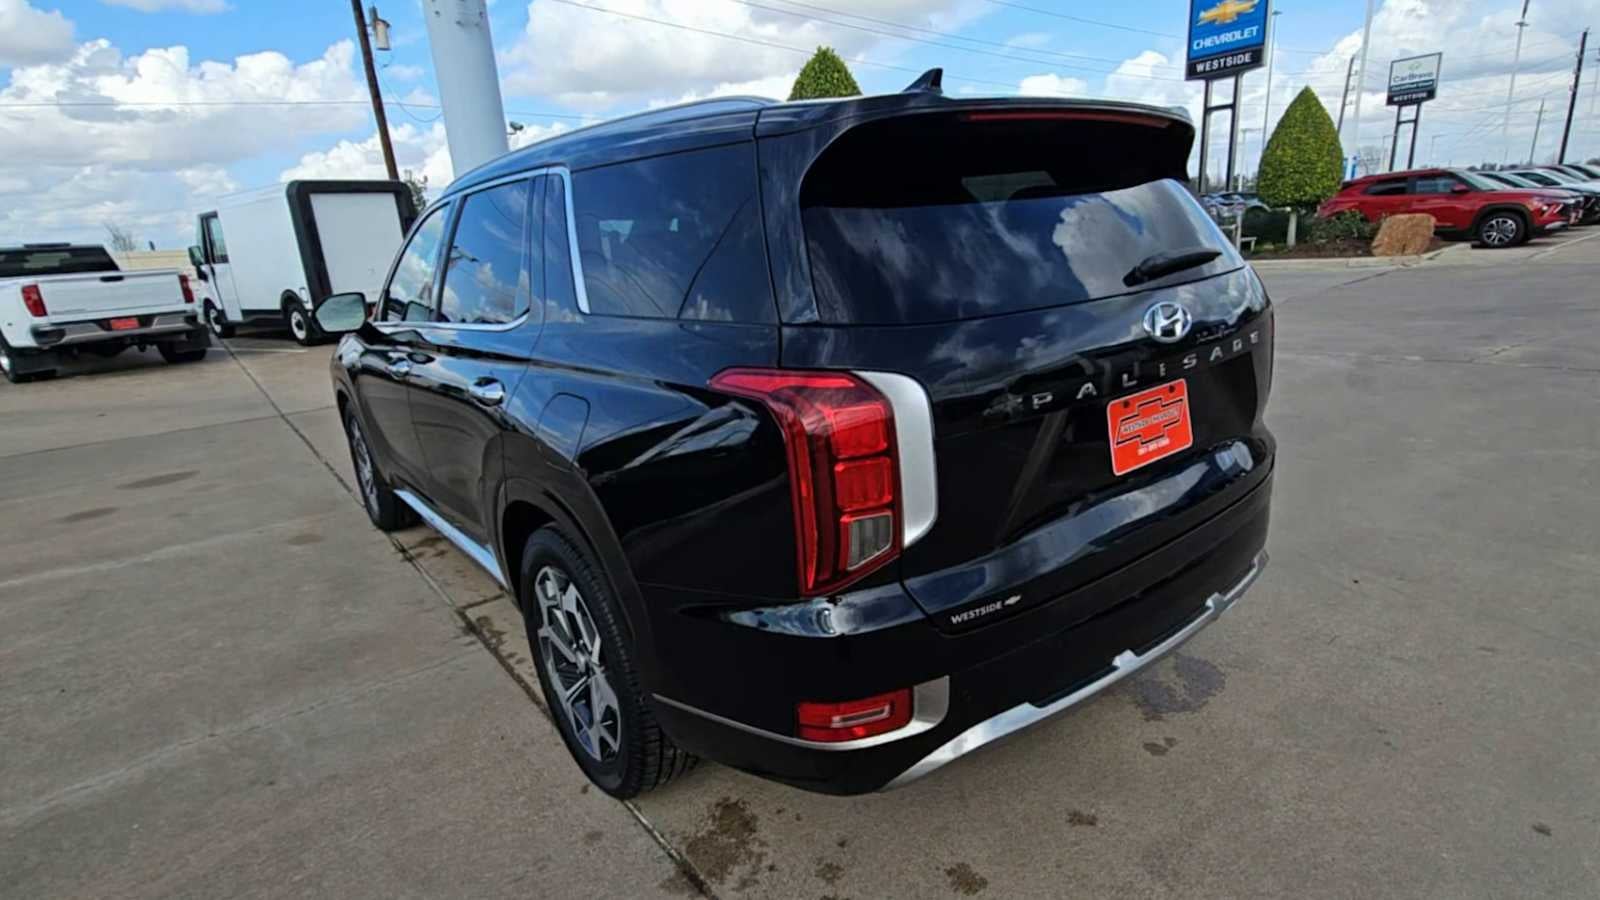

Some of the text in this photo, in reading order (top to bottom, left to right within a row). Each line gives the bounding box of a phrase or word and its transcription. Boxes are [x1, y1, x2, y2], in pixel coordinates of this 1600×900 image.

[1193, 25, 1259, 50] CHEVROLET
[1195, 52, 1252, 73] WESTSIDE
[1032, 331, 1260, 410] PALISADE
[951, 601, 1002, 624] WESTSIDE
